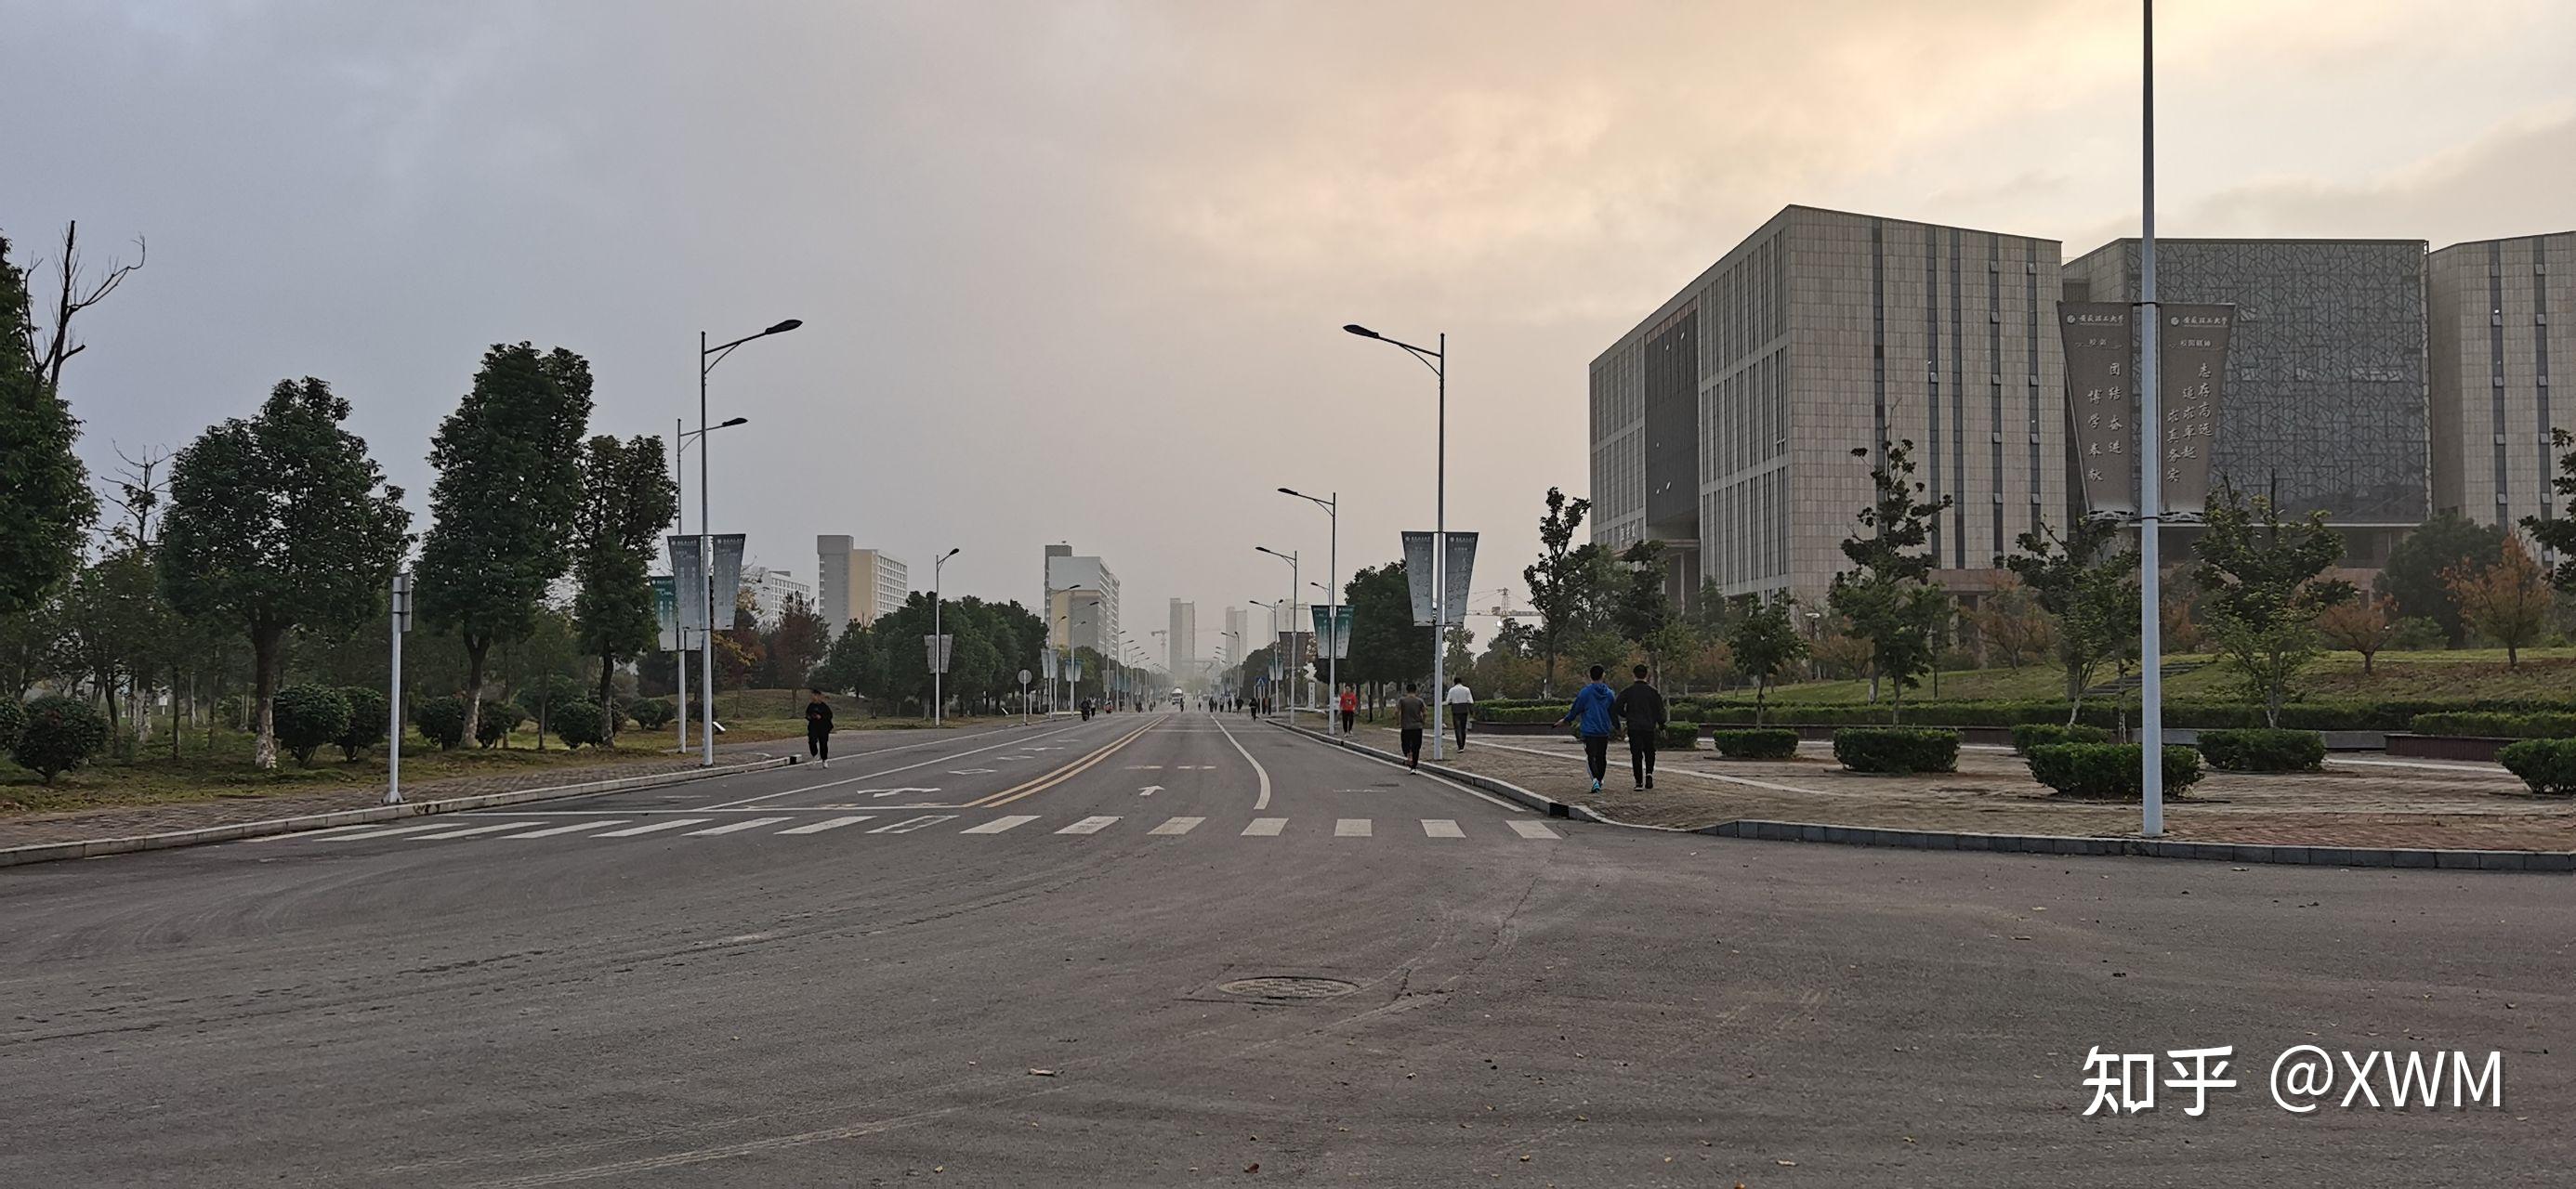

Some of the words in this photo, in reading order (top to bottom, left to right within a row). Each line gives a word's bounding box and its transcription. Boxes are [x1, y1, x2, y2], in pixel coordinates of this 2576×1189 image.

[2087, 387, 2104, 482] 博学奉献
[2108, 362, 2123, 455] 团结奋进
[2181, 386, 2198, 460] 追求卓越
[2197, 362, 2214, 438] 志存高远
[2166, 409, 2182, 483] 求真务实
